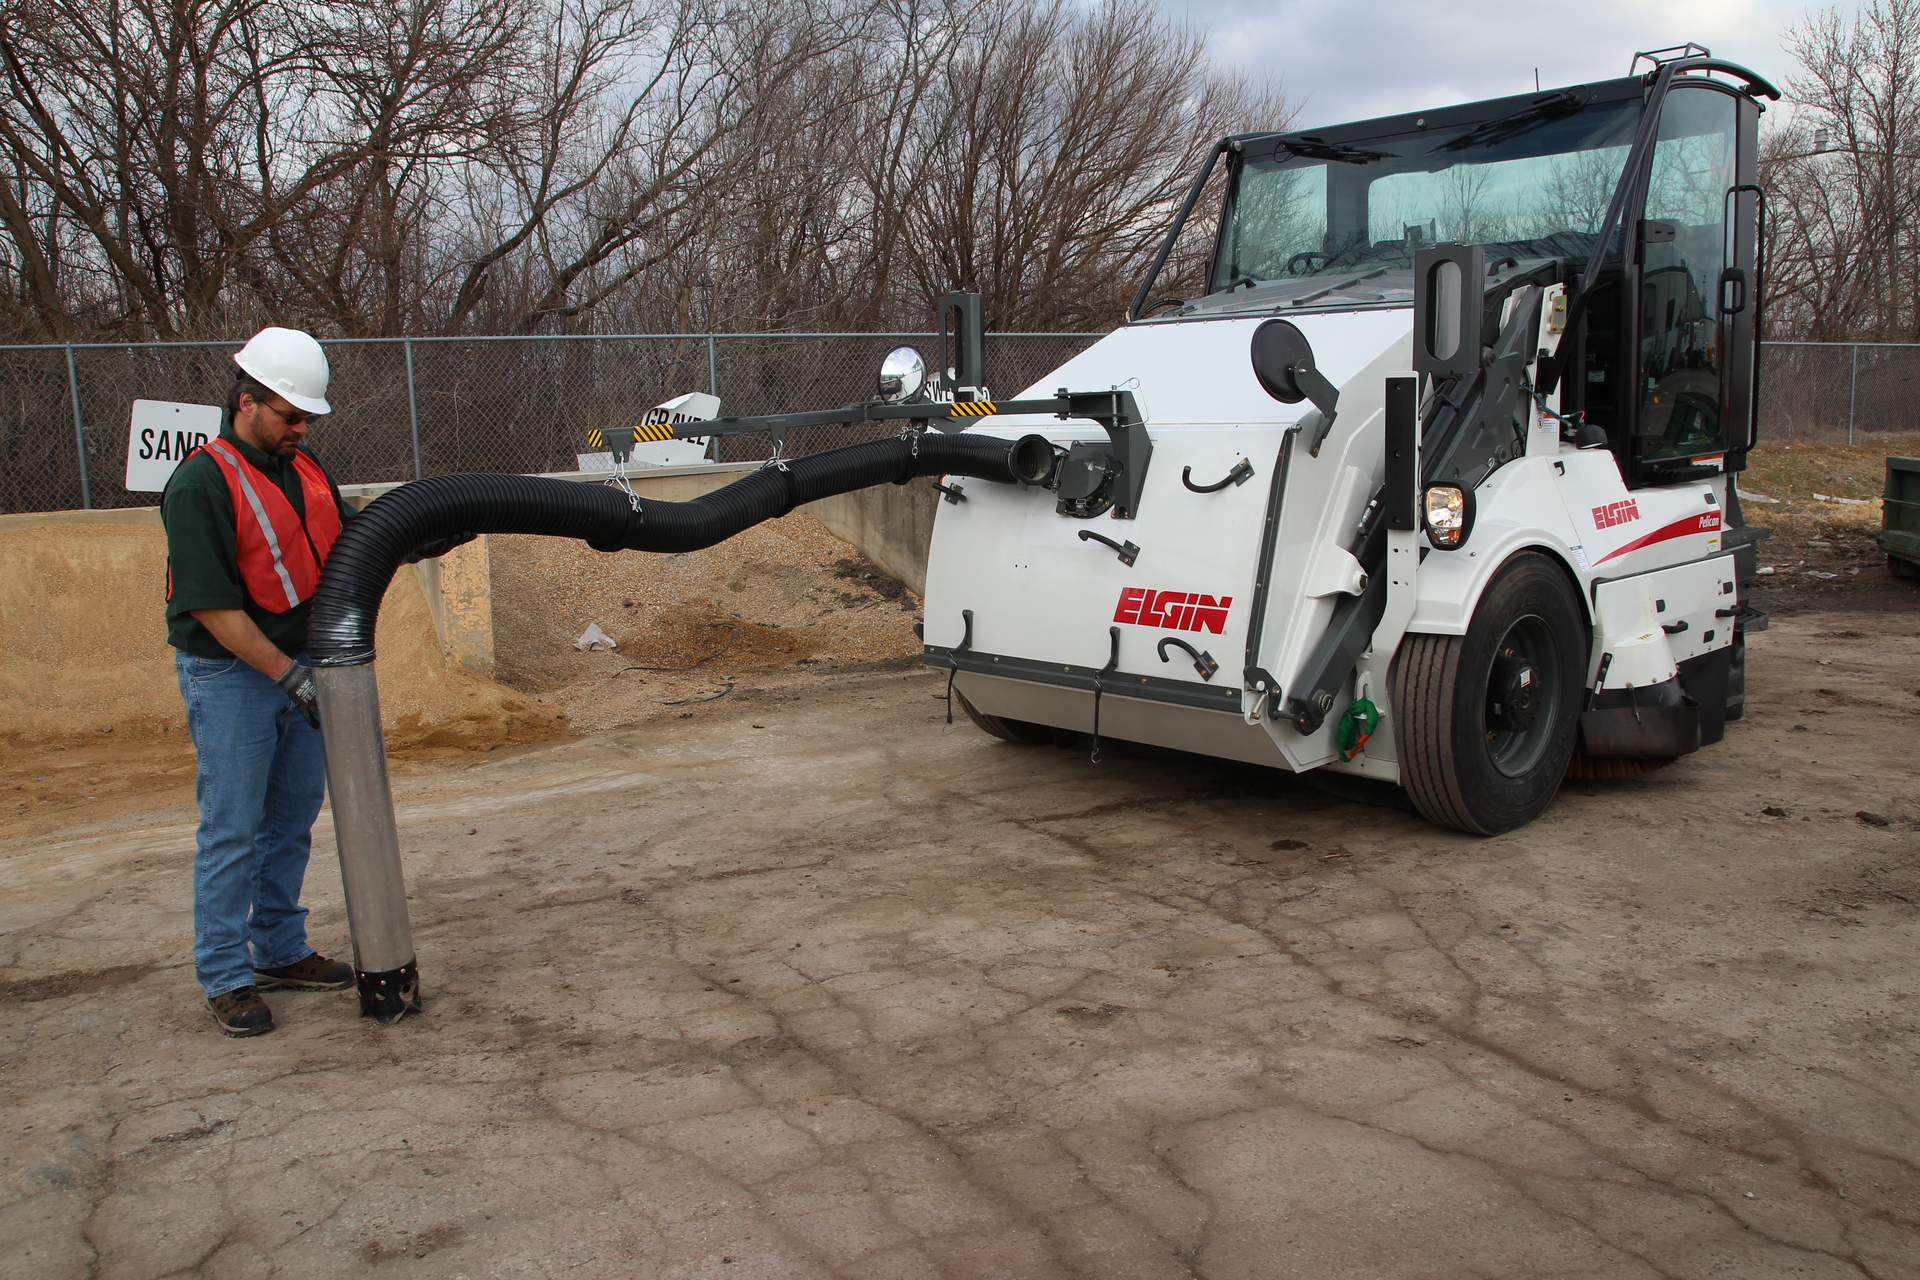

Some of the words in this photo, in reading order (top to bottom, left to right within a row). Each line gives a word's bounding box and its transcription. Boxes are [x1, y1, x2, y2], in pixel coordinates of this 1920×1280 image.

[1591, 498, 1640, 530] ELGIN
[1698, 515, 1719, 528] Pelican
[1113, 587, 1233, 634] ELGIN
